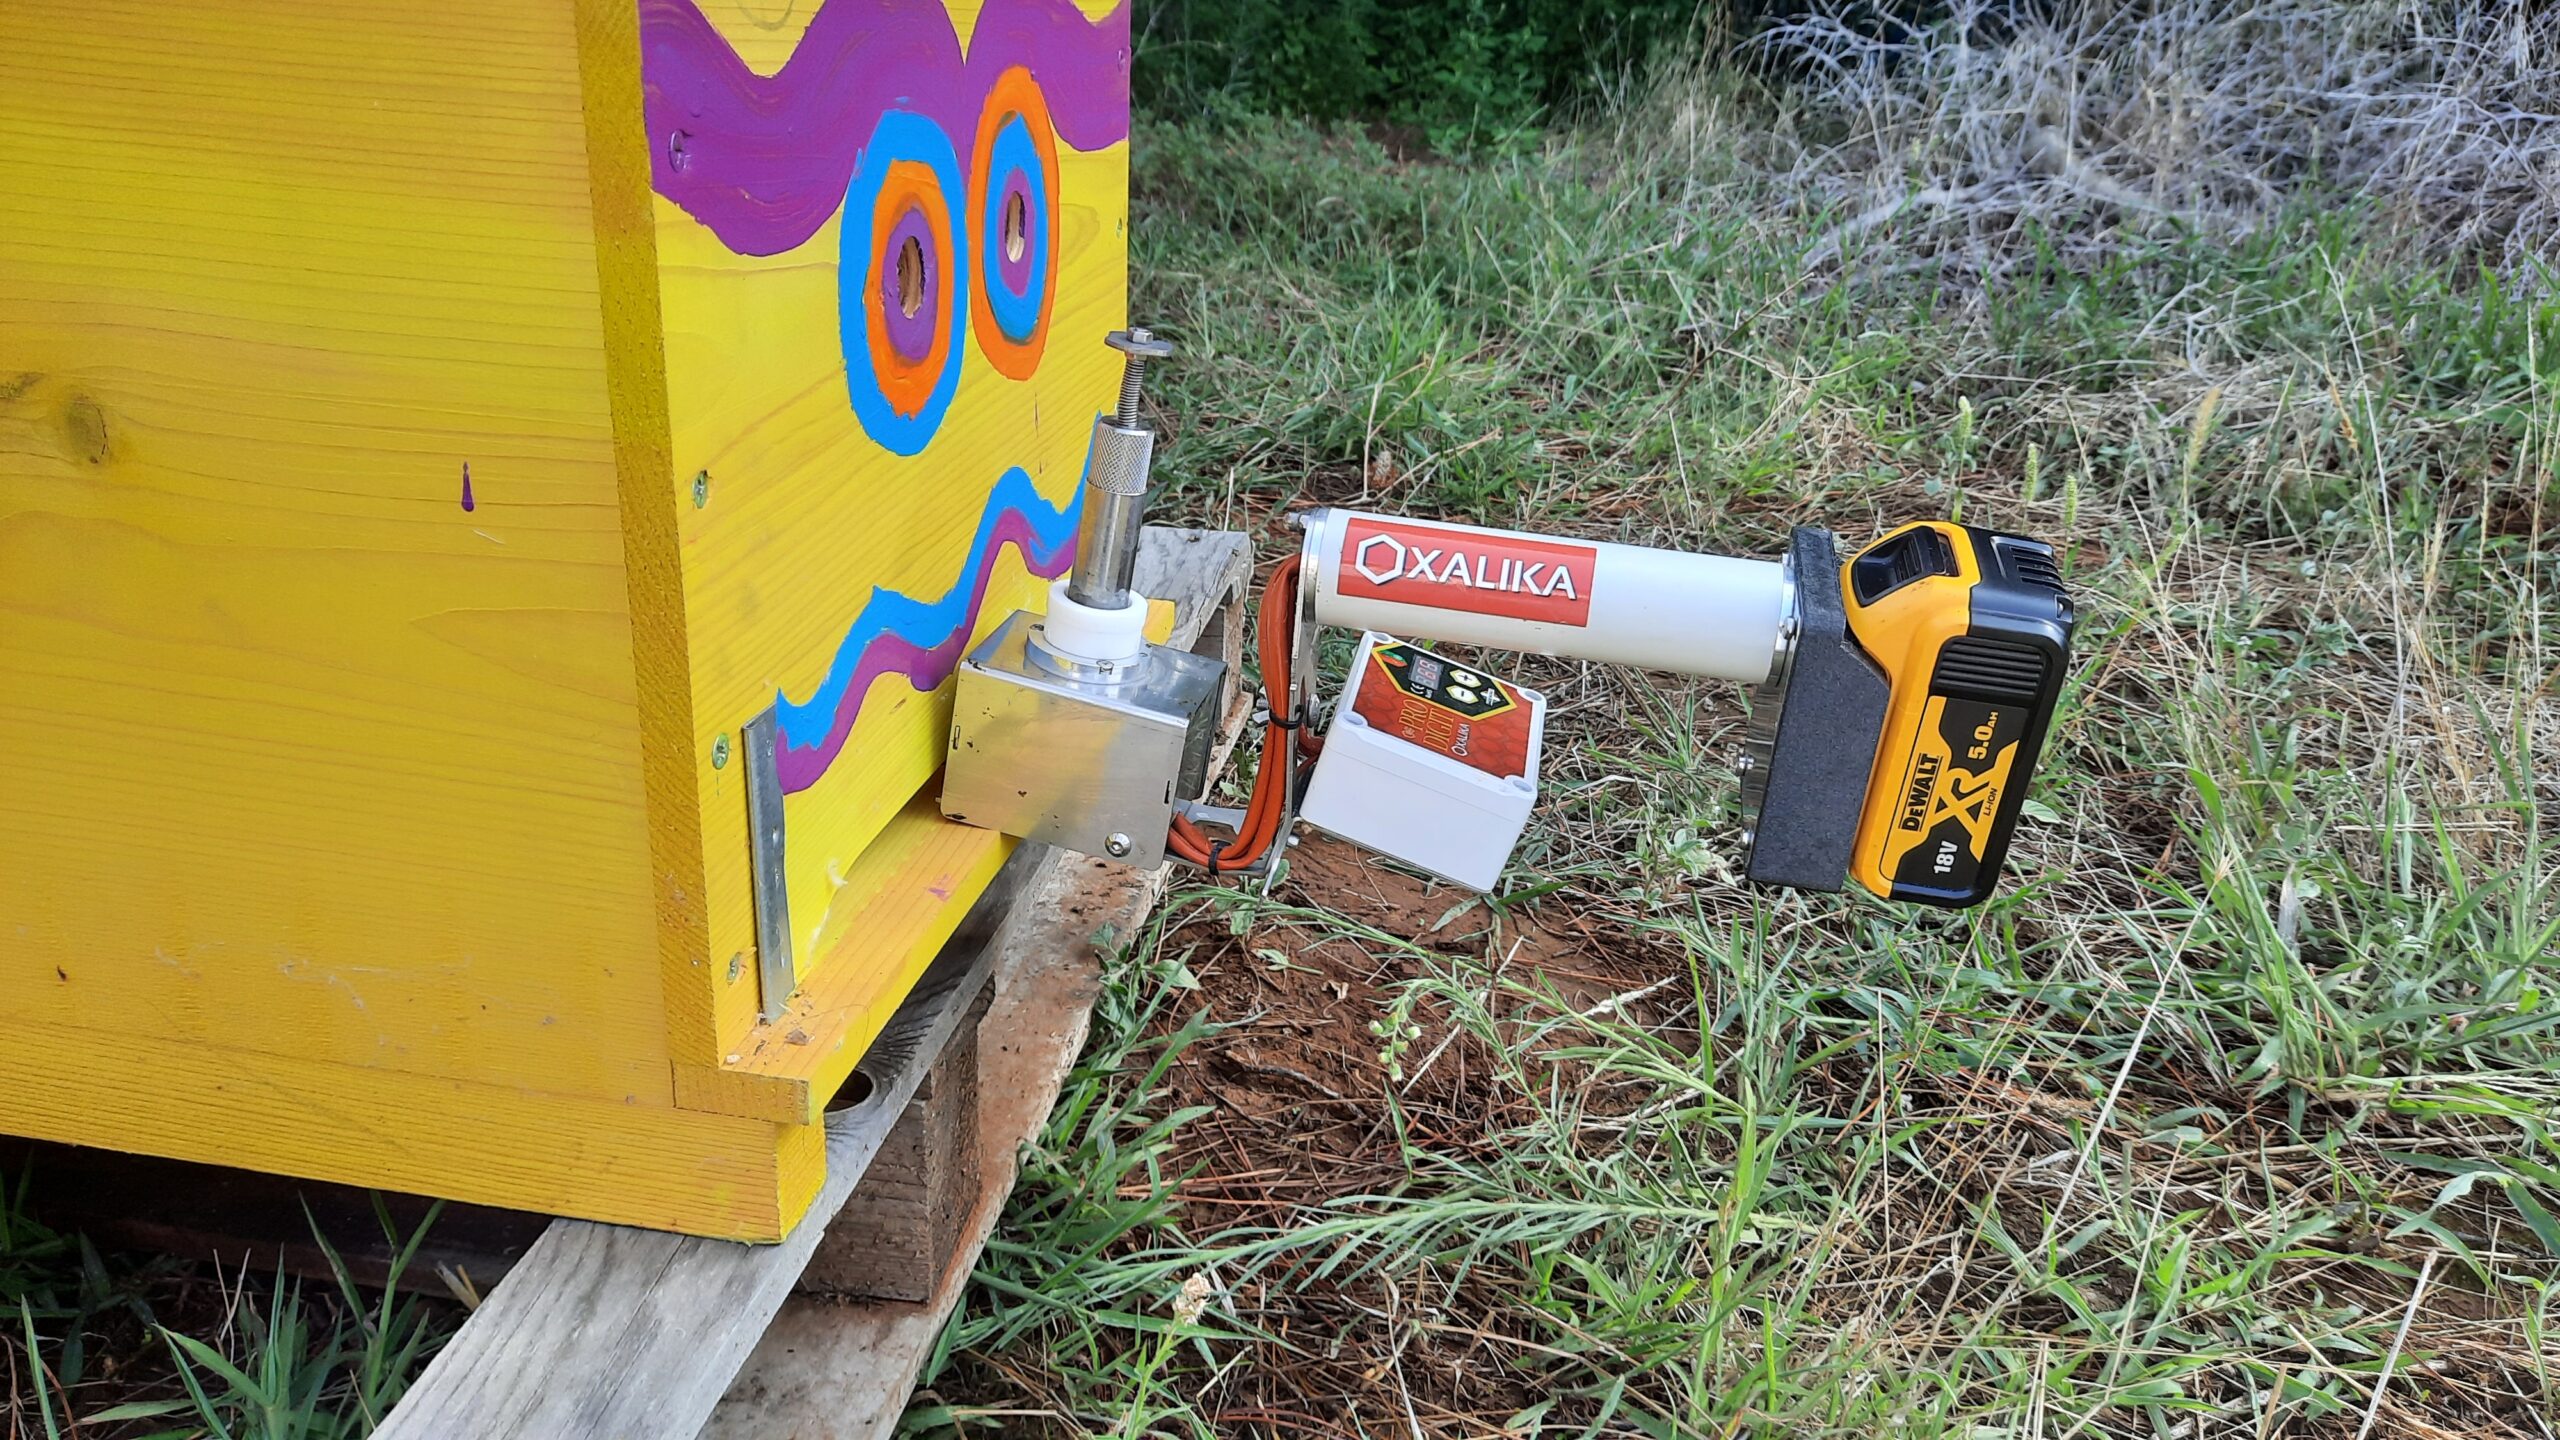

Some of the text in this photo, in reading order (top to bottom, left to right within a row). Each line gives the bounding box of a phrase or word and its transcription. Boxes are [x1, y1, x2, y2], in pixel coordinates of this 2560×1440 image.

[1355, 534, 1577, 600] OXALIKA
[1399, 699, 1428, 731] PRO
[1423, 708, 1454, 752] DIGIT
[1451, 723, 1470, 756] OXALIKA
[1983, 787, 1998, 817] LI-ION
[1933, 840, 1959, 874] 18V
